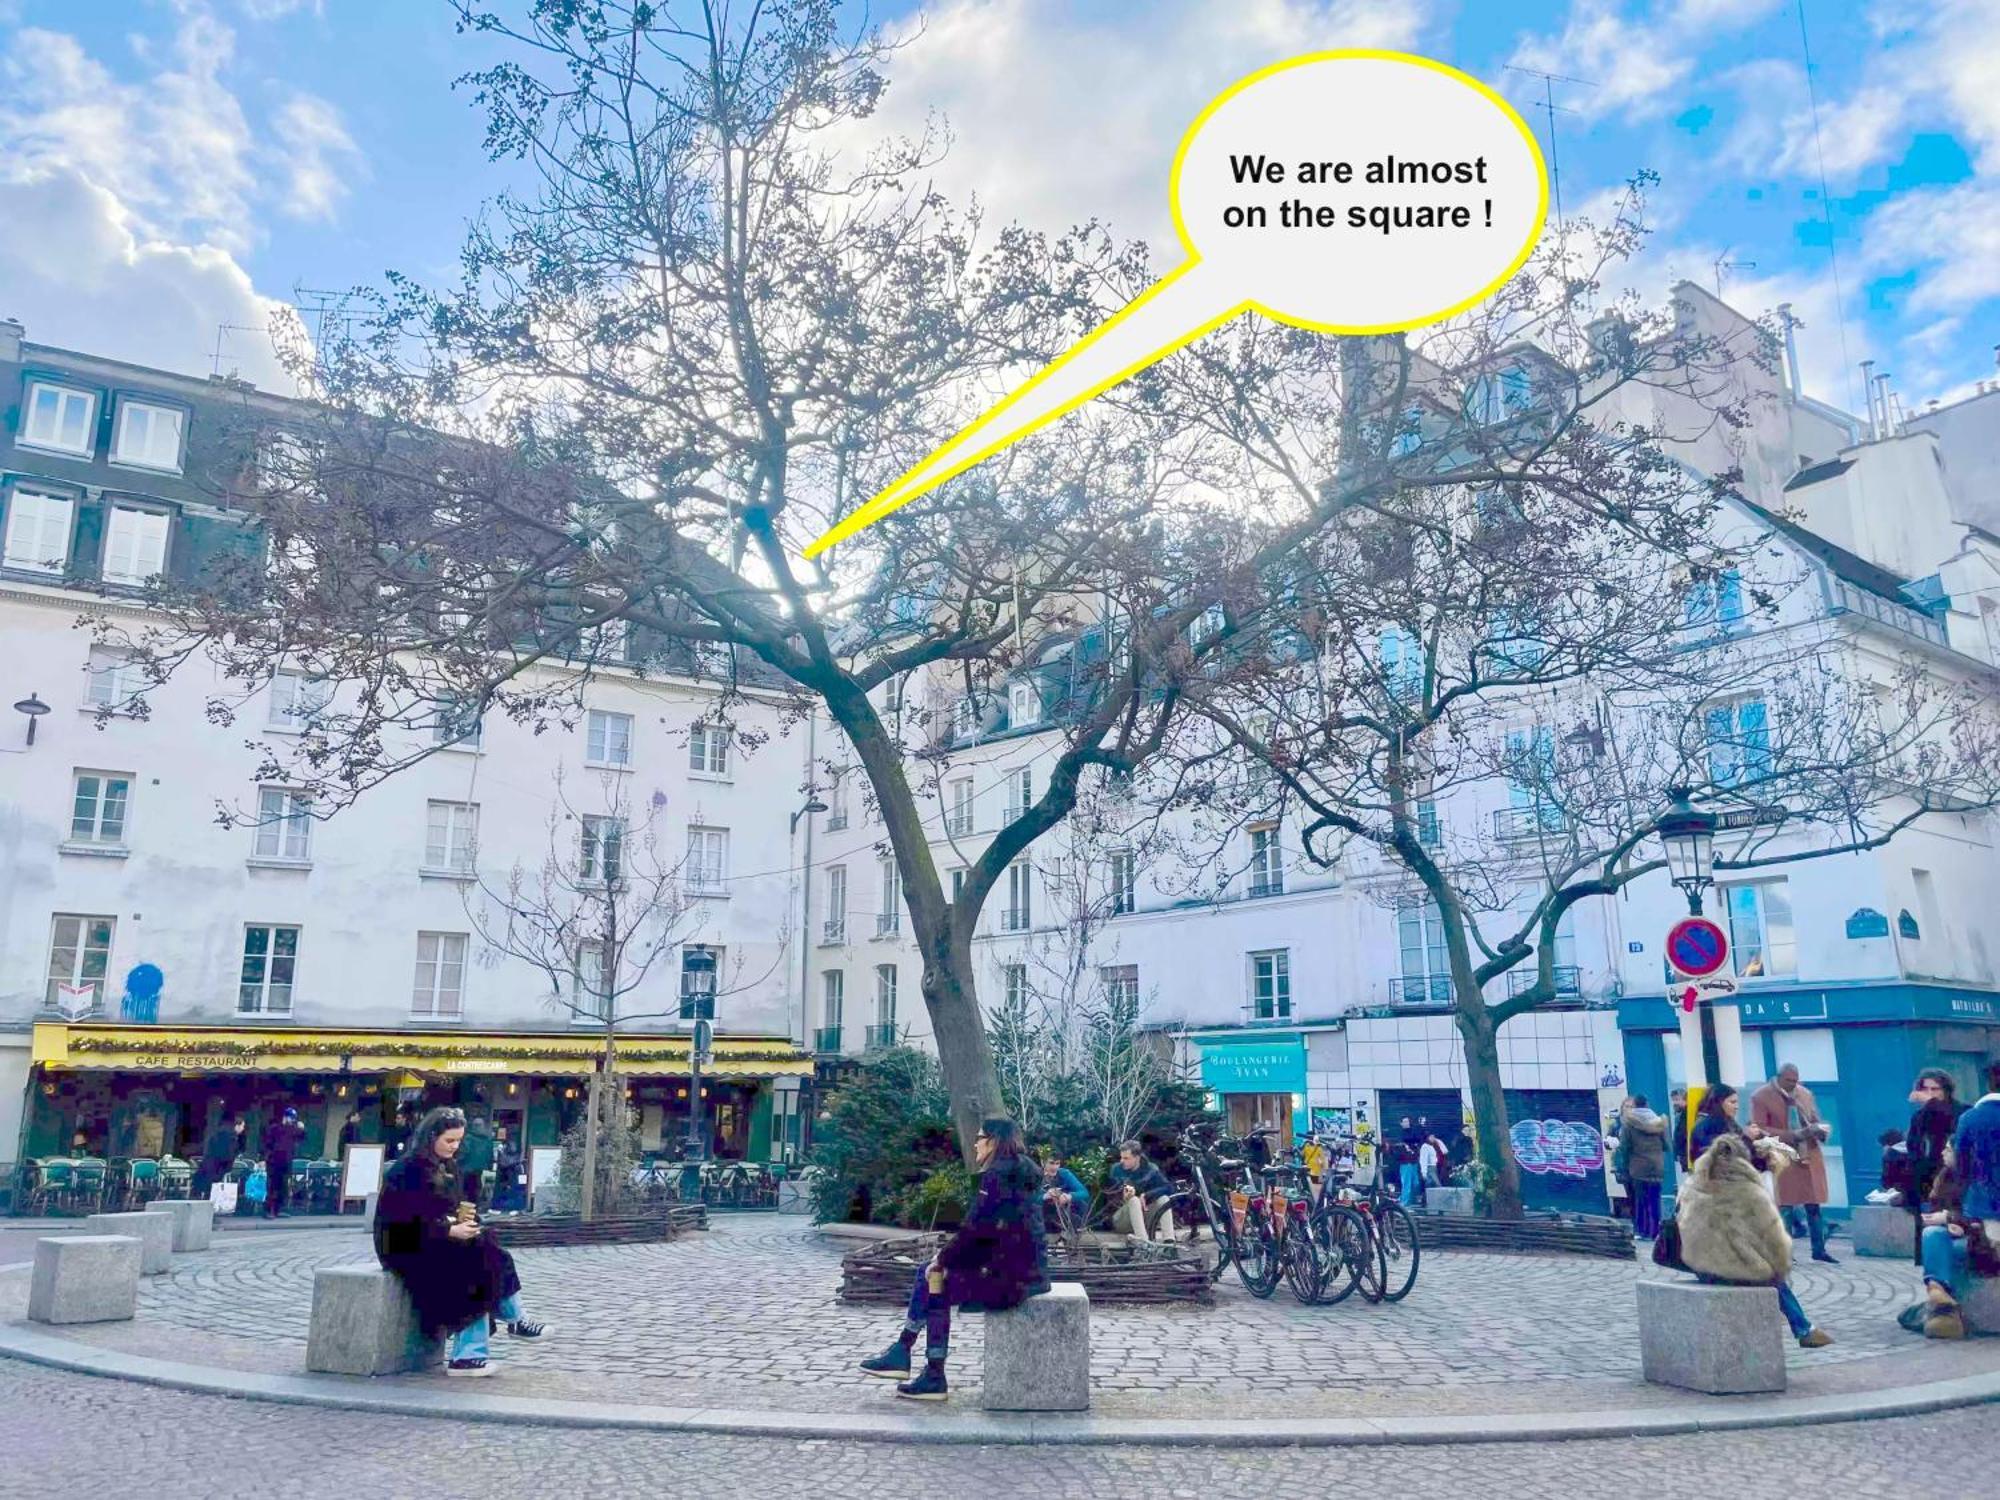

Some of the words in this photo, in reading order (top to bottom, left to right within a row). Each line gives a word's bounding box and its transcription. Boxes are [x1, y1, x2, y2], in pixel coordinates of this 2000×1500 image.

[1744, 1000, 1791, 1016] DA'S
[177, 1055, 258, 1067] RESTAURANT
[1209, 1054, 1291, 1066] BOULANGERIE
[1233, 1066, 1270, 1078] YVAN
